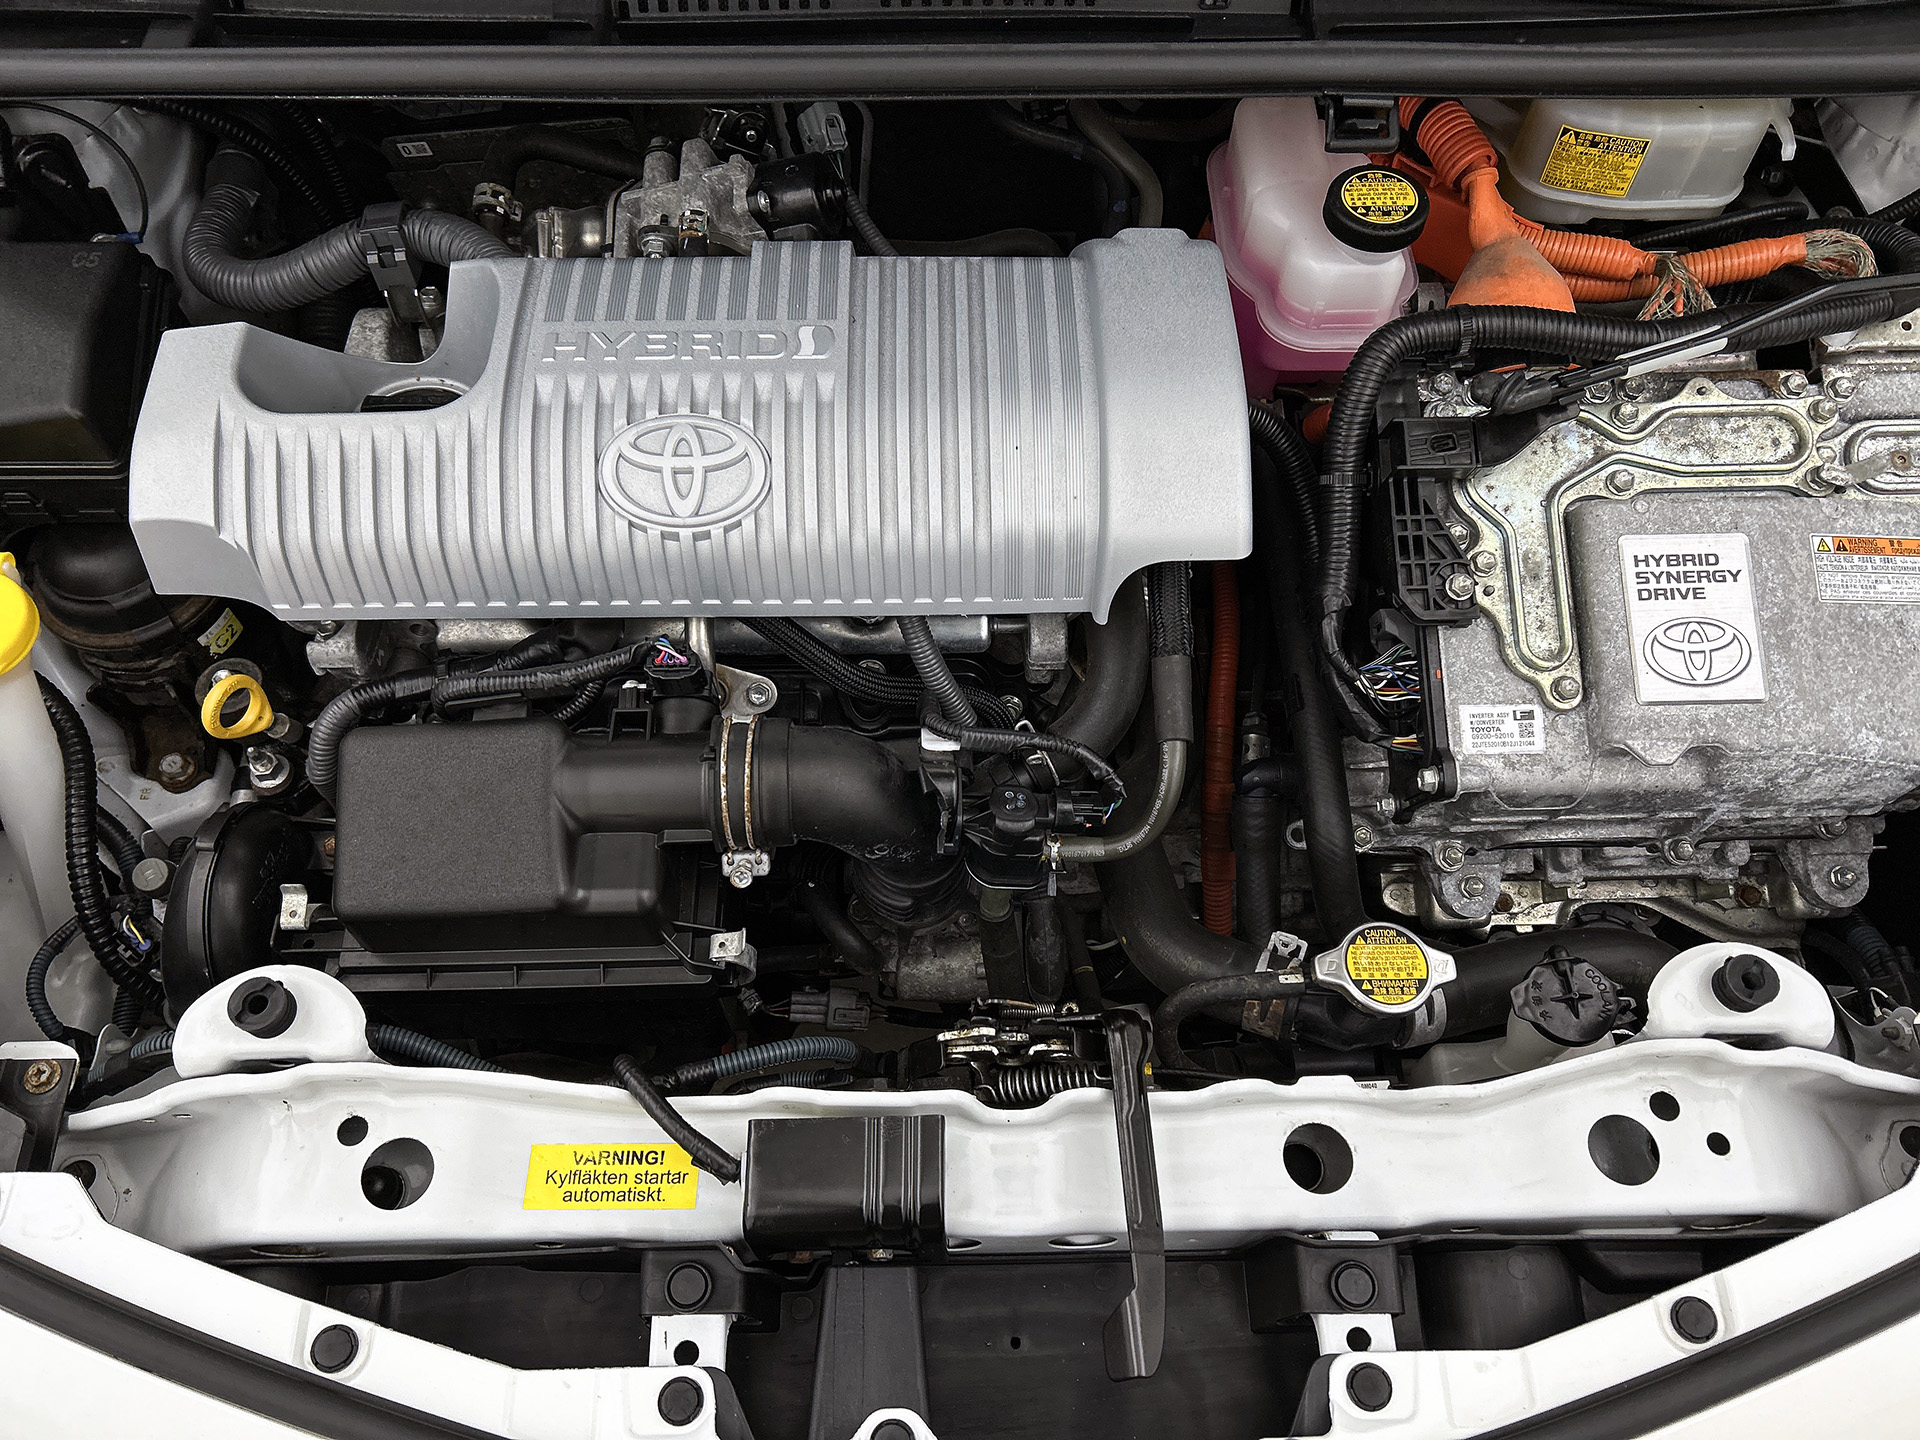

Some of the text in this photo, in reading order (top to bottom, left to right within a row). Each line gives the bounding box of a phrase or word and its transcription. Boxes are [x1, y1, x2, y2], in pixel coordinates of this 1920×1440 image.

[1598, 143, 1643, 154] ATTENTION
[1610, 138, 1645, 148] CAUTION
[542, 331, 788, 362] HYBRID
[1847, 538, 1878, 546] WARNING
[1633, 553, 1720, 568] HYBRID
[1635, 569, 1742, 585] SYNERGY
[1637, 587, 1707, 601] DRIVE
[216, 623, 238, 649] C2
[1471, 732, 1515, 740] G9200-52010
[1364, 929, 1397, 937] CAUTION
[1372, 980, 1419, 988] ВНИМАНИЕ!
[573, 1150, 665, 1166] VARNING!
[545, 1169, 628, 1189] Kylfläkten
[562, 1187, 666, 1202] automatiskt.
